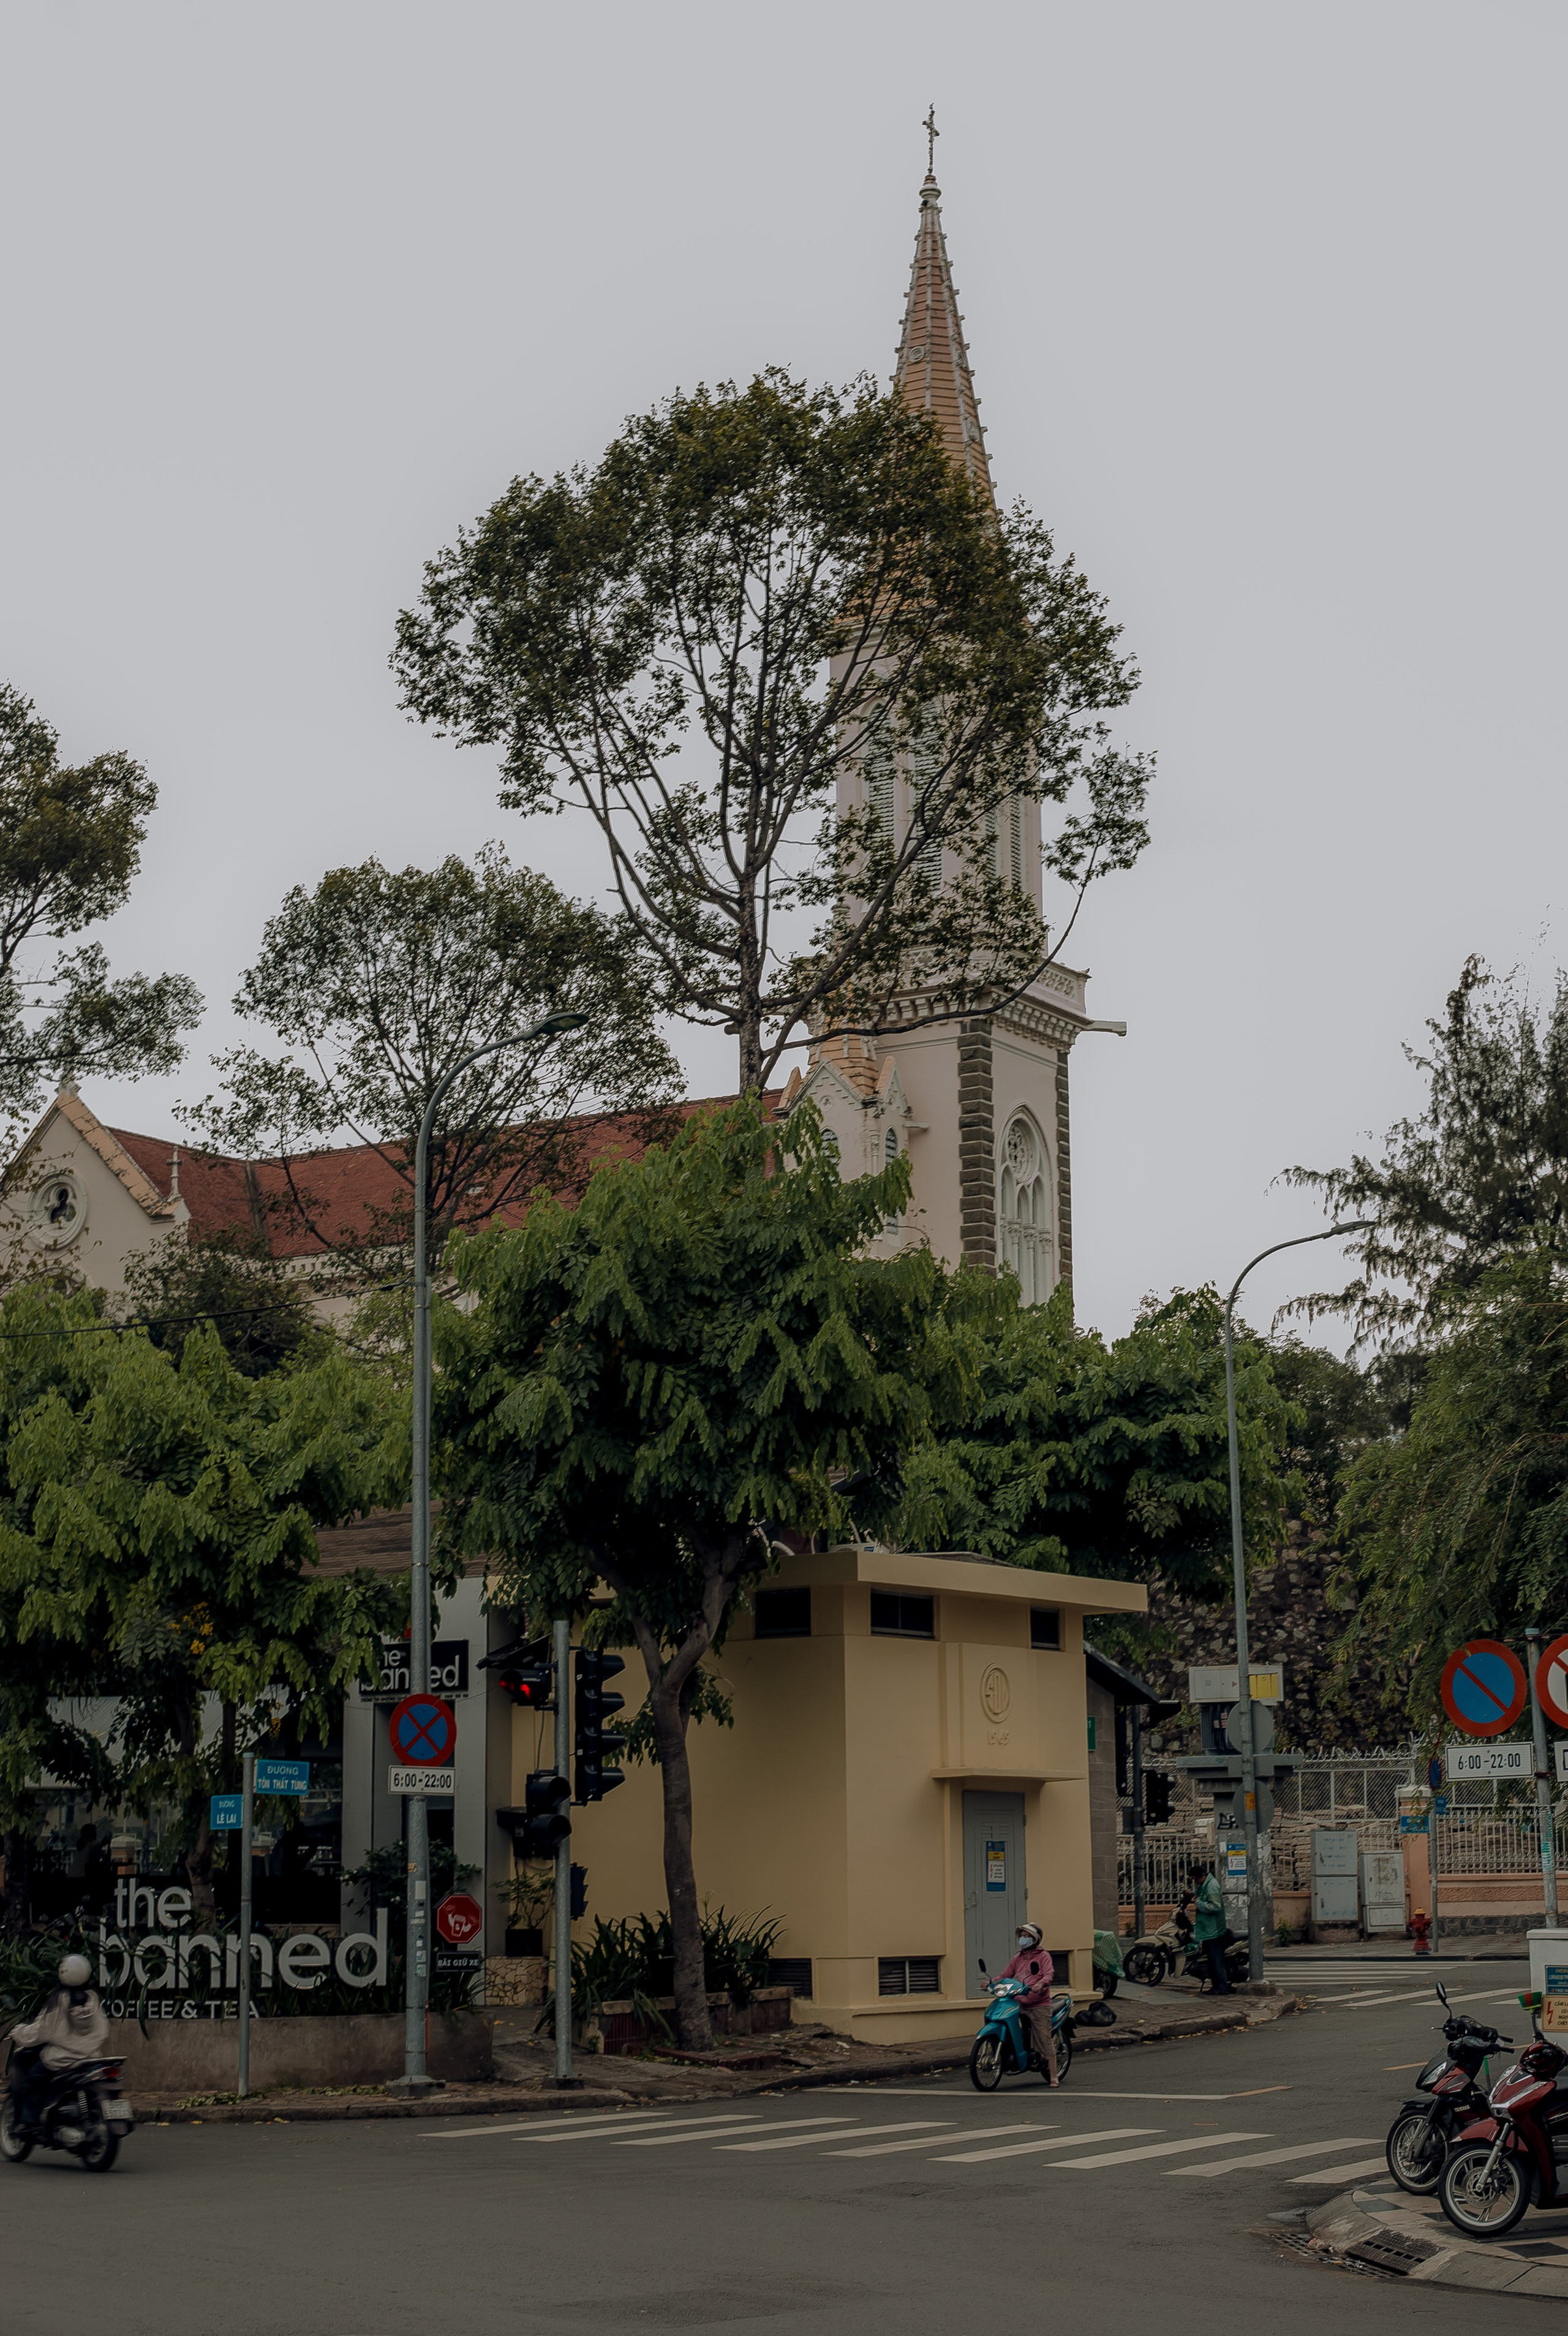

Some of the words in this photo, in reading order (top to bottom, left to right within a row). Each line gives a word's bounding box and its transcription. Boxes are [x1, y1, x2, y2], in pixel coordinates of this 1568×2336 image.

[115, 1877, 192, 1928] the
[99, 1907, 388, 1990] banned
[99, 1999, 174, 2019] COFFEE
[181, 2000, 198, 2019] &
